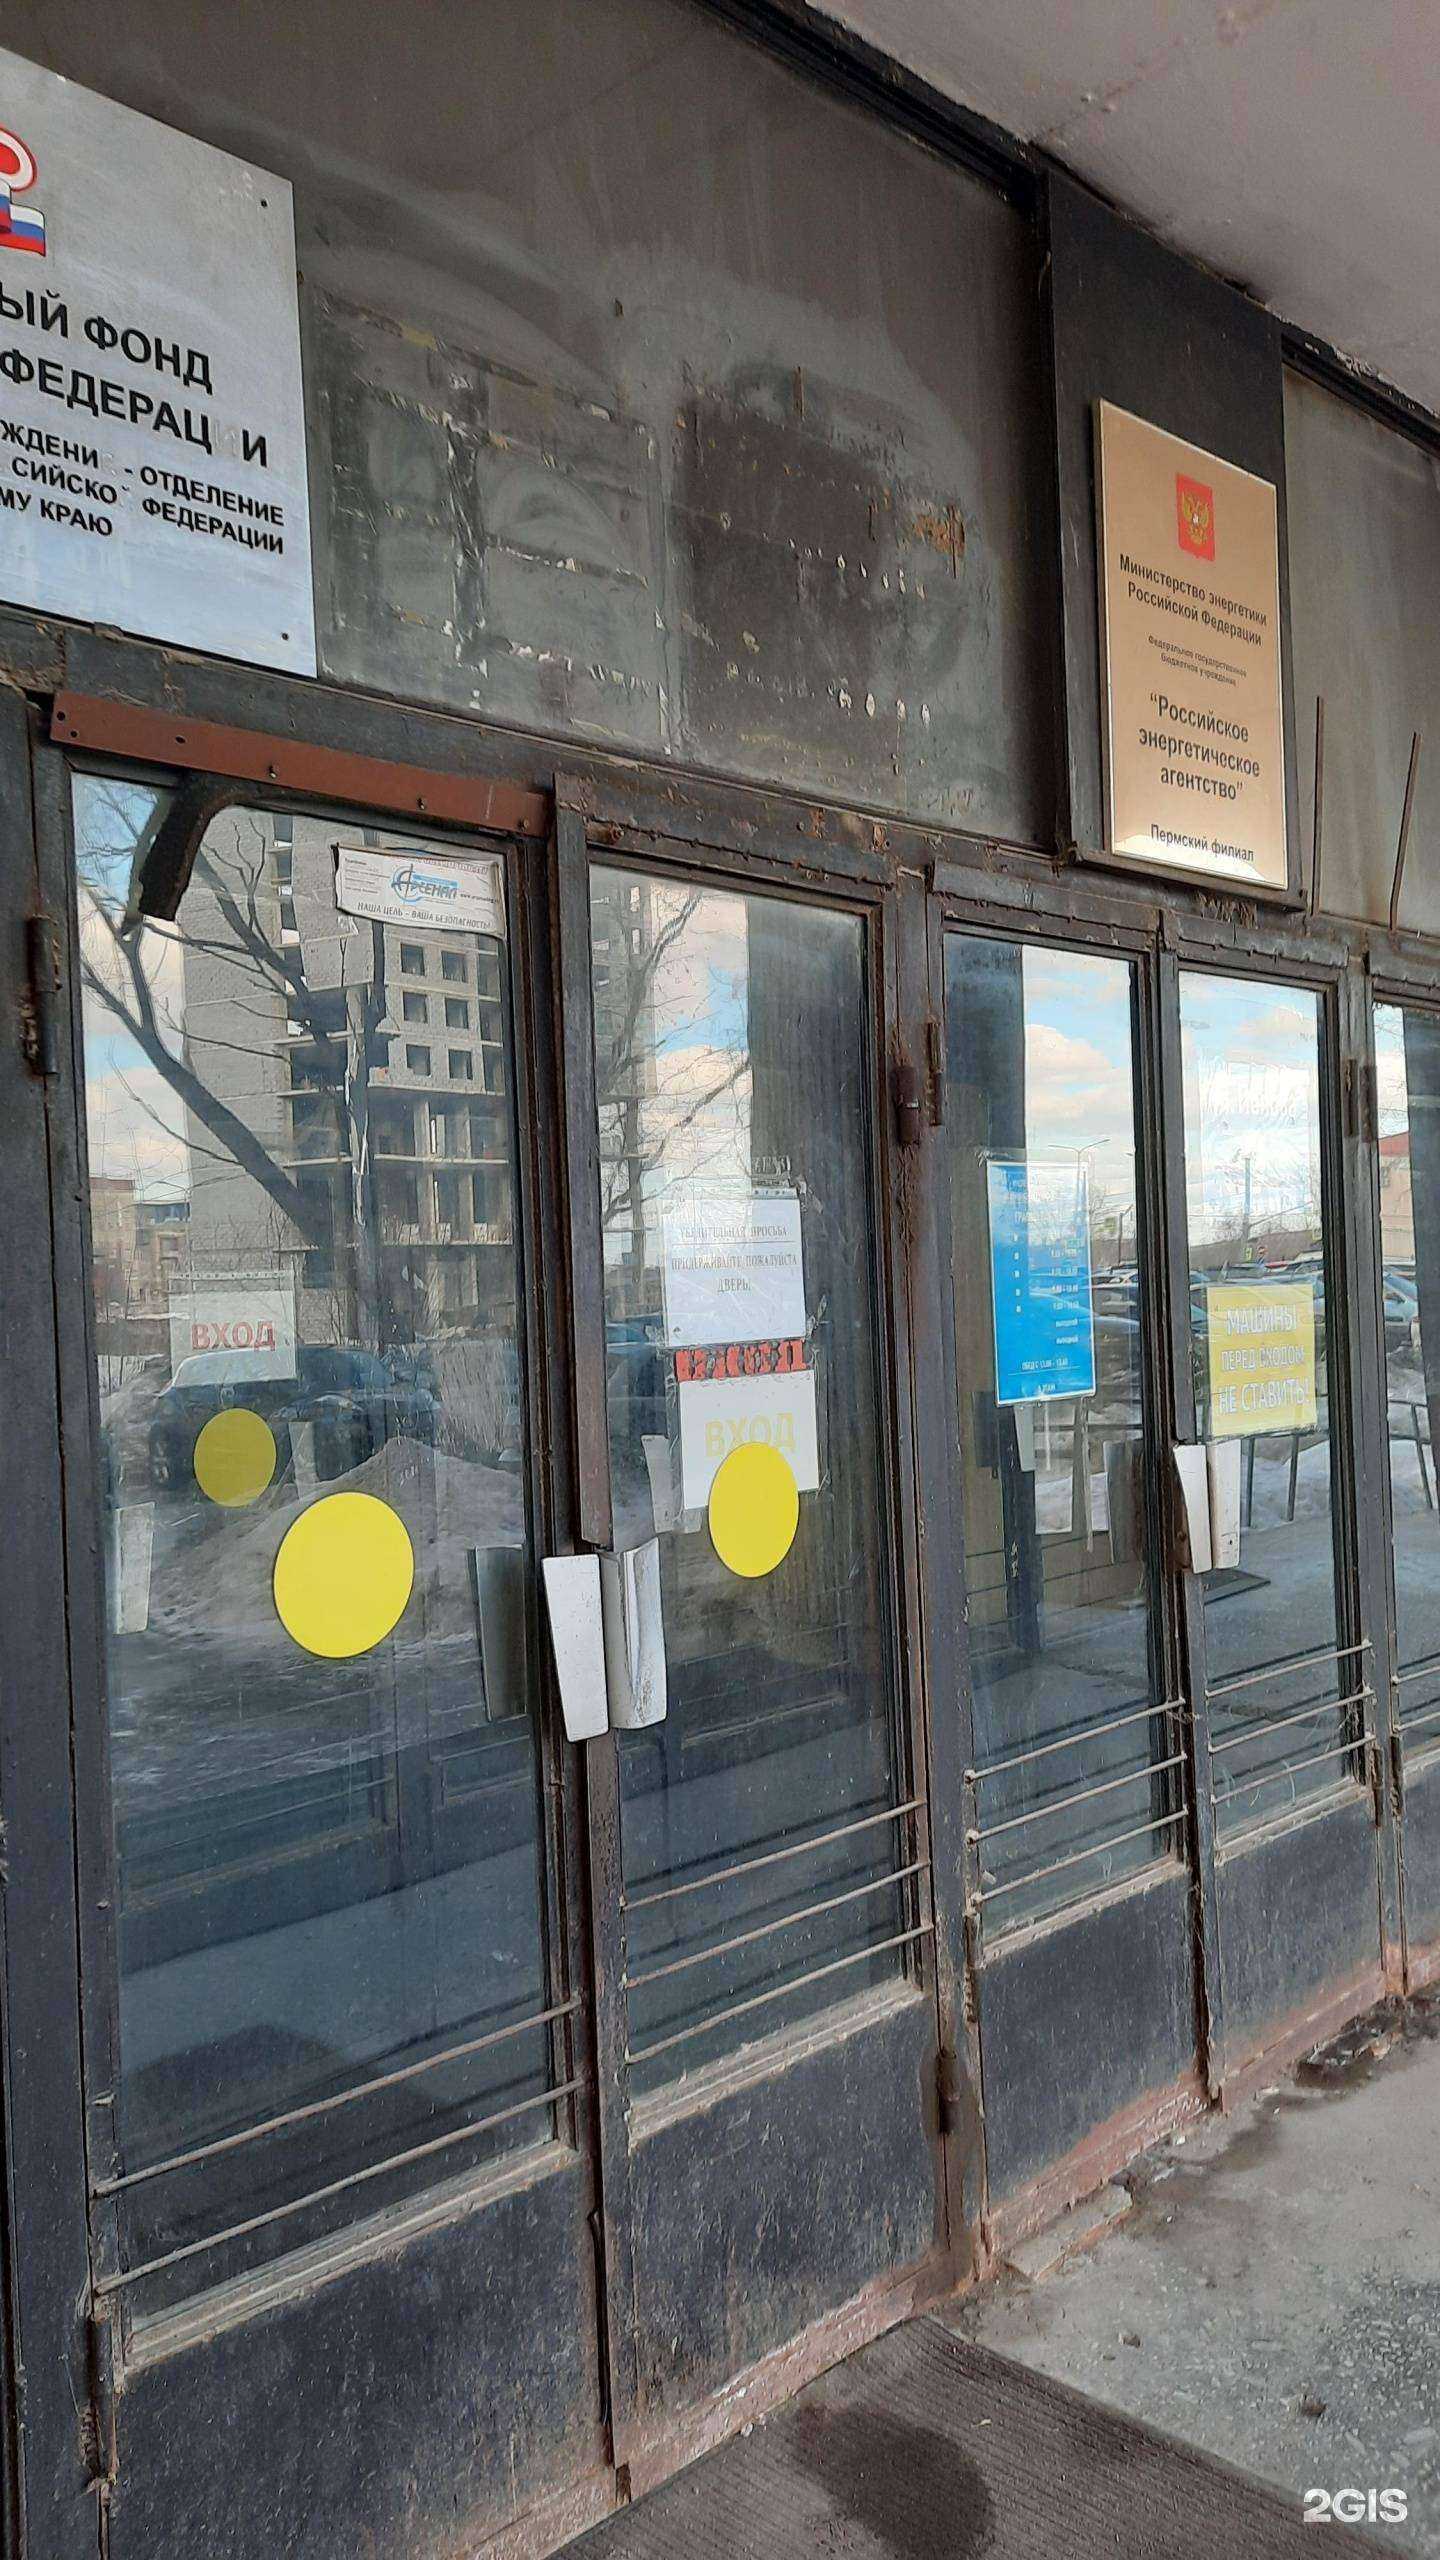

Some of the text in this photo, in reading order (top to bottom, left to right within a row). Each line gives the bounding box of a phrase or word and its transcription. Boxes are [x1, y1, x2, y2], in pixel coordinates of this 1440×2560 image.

[83, 315, 214, 396] ФОНД
[0, 348, 268, 468] ФЕДЕРАЦИ
[40, 497, 114, 536] КРАЮ
[140, 466, 285, 527] ОТДЕЛЕНИЕ
[142, 497, 284, 555] ФЕДЕРАЦИИ
[1120, 553, 1267, 626] Министерство энергетики
[1128, 581, 1262, 646] Российской Федерации
[1139, 728, 1260, 777] энергетическое
[1151, 823, 1254, 862] Пермский филиал
[191, 1320, 276, 1352] ВХОД
[1226, 1304, 1298, 1335] МАШИНЫ
[1221, 1348, 1257, 1373] ПЕРЕД
[1218, 1382, 1238, 1415] НЕ
[705, 1412, 797, 1457] ВХОД
